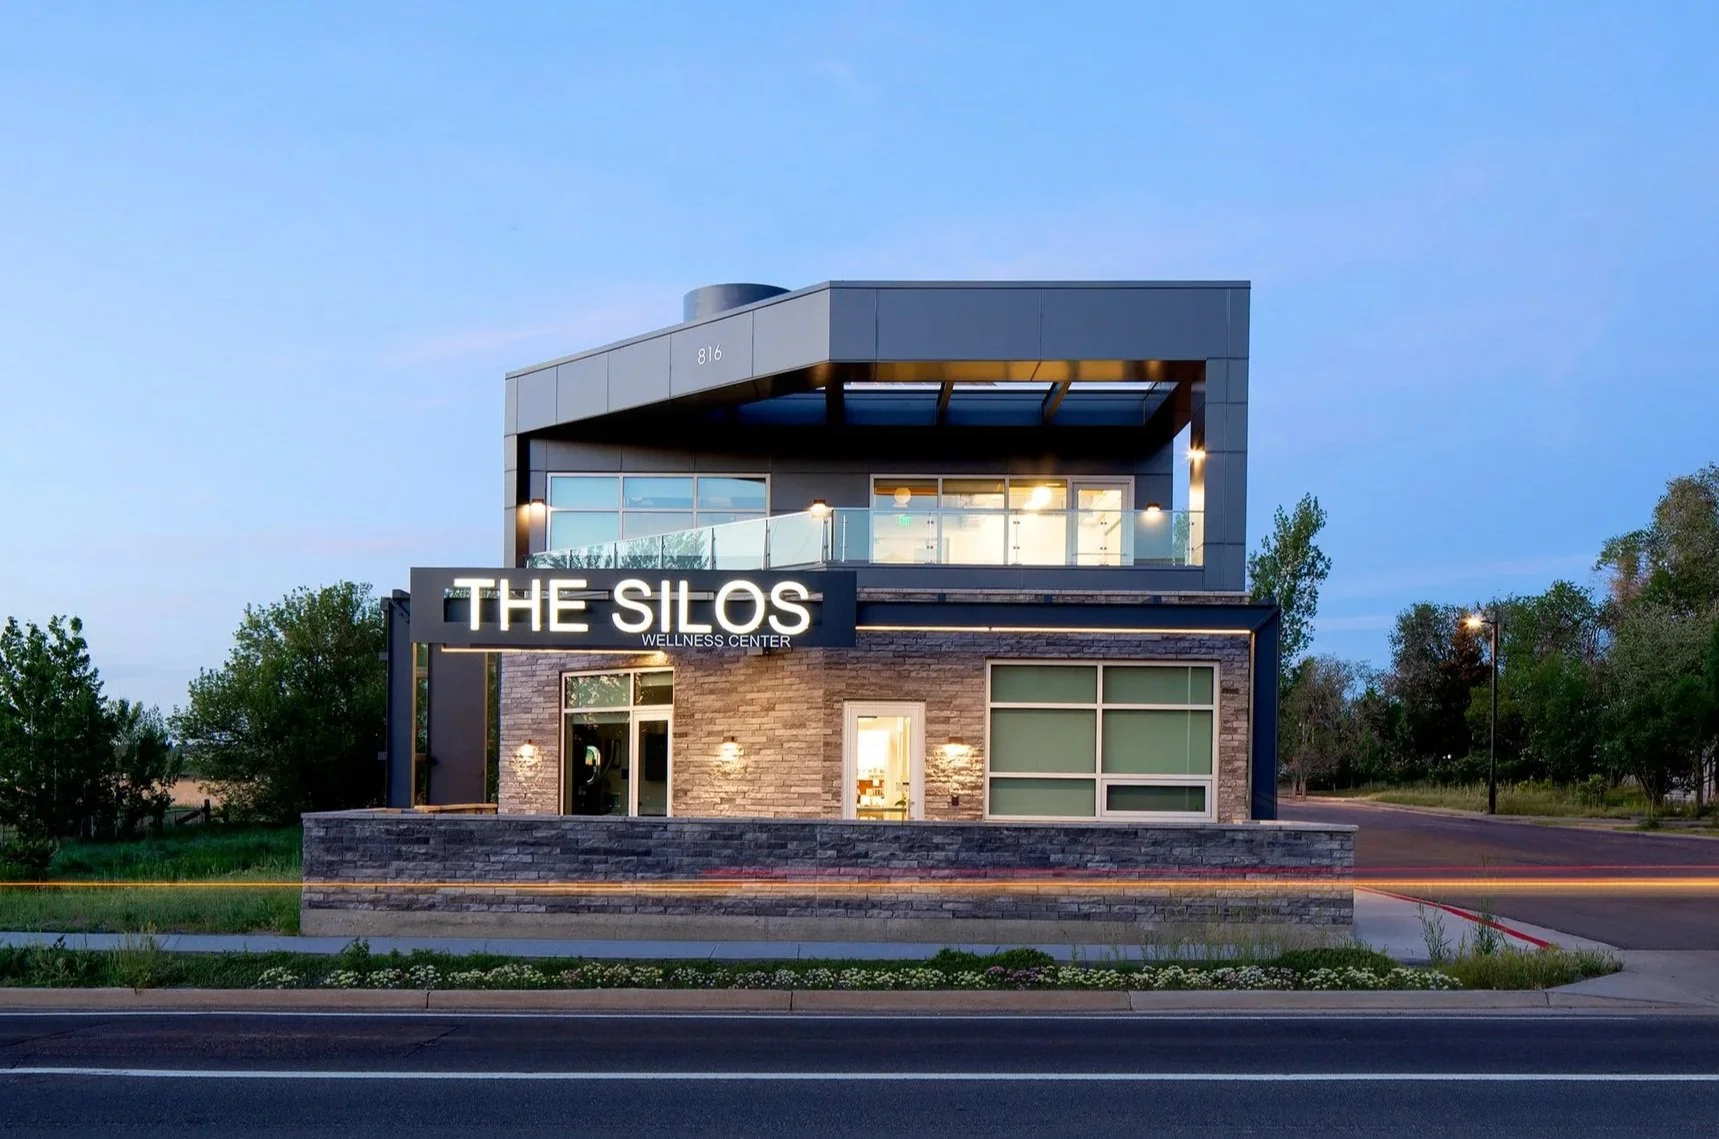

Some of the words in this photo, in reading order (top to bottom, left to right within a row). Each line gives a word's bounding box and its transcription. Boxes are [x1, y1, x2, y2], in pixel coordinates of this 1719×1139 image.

[697, 344, 722, 365] 816
[454, 578, 589, 632] THE
[611, 578, 811, 635] SILOS
[641, 634, 724, 647] WELLNESS
[728, 634, 792, 648] CENTER
